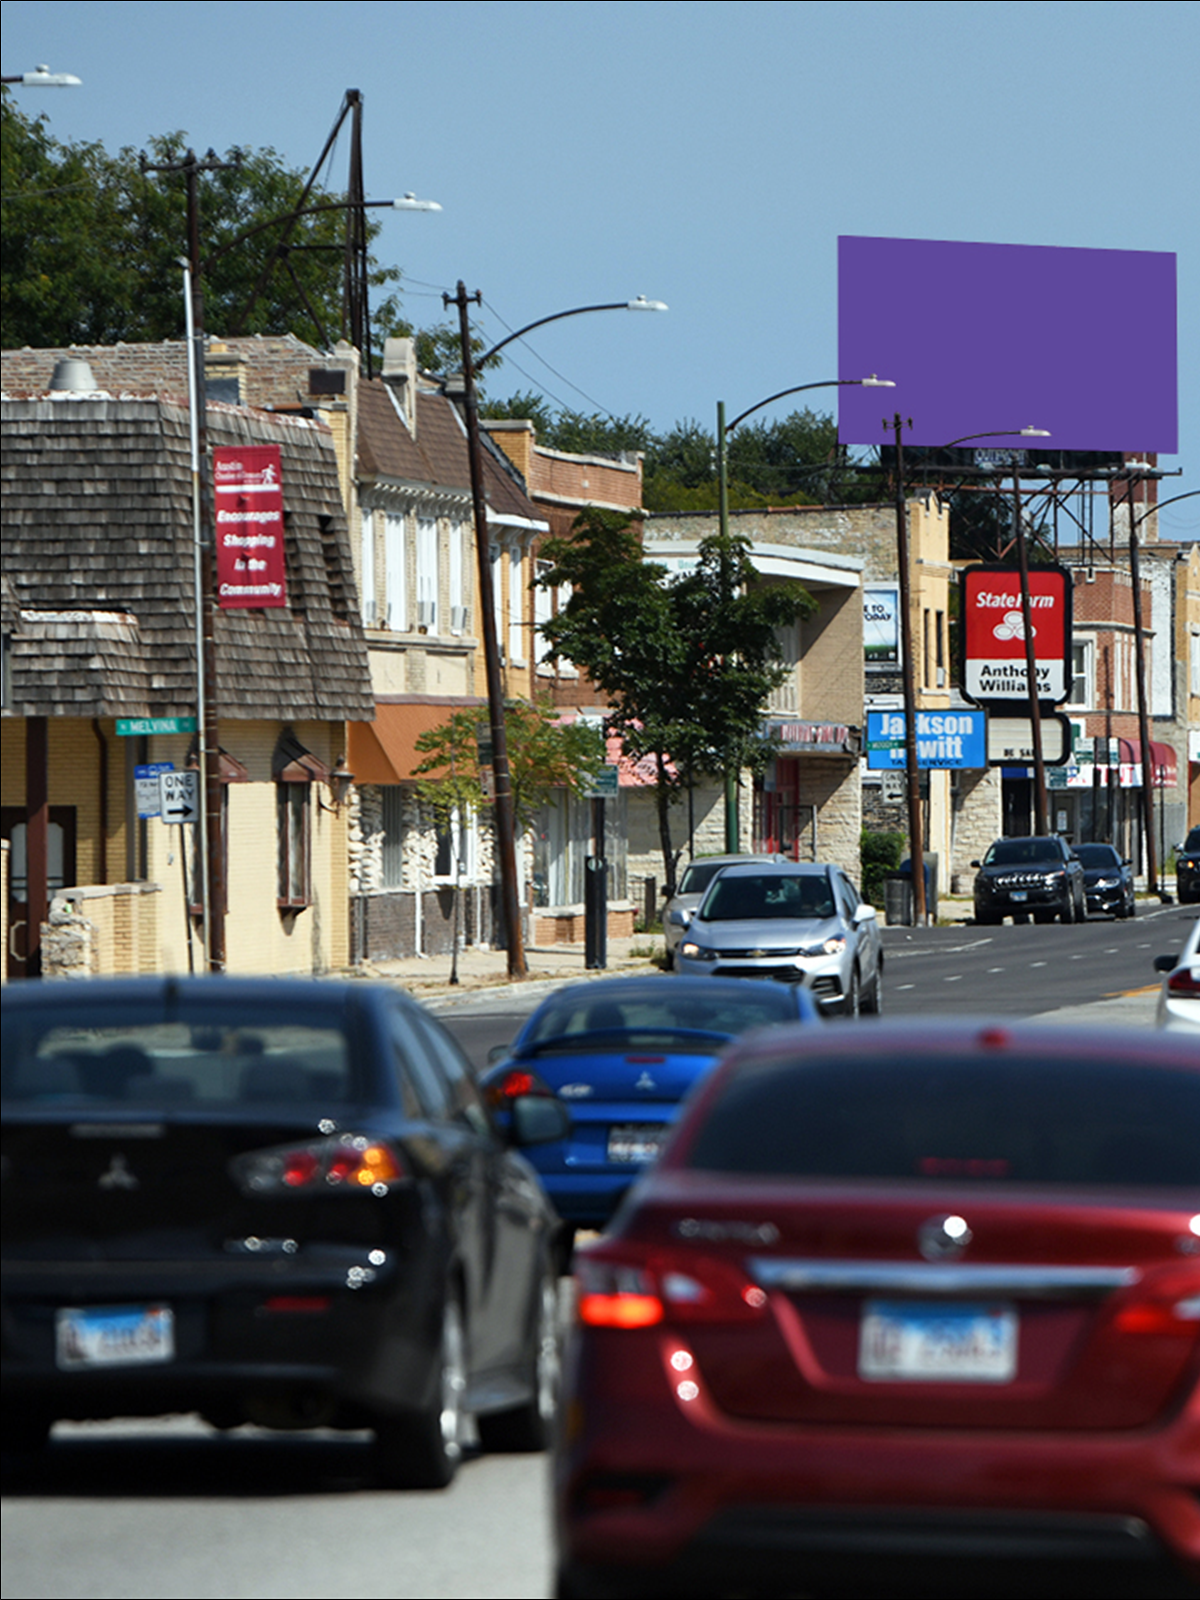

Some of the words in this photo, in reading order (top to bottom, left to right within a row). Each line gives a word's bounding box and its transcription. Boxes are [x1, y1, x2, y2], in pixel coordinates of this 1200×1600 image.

[217, 510, 280, 524] Encourages
[223, 533, 276, 548] Shopping
[234, 558, 246, 570] in
[247, 558, 267, 571] the
[219, 582, 282, 597] Community
[1015, 592, 1055, 608] Frm
[979, 679, 1051, 692] Willias
[129, 719, 178, 732] MELVINA
[880, 713, 973, 735] Jakson
[889, 736, 963, 759] Hwitt
[164, 774, 193, 788] ONE
[164, 789, 194, 801] WAY
